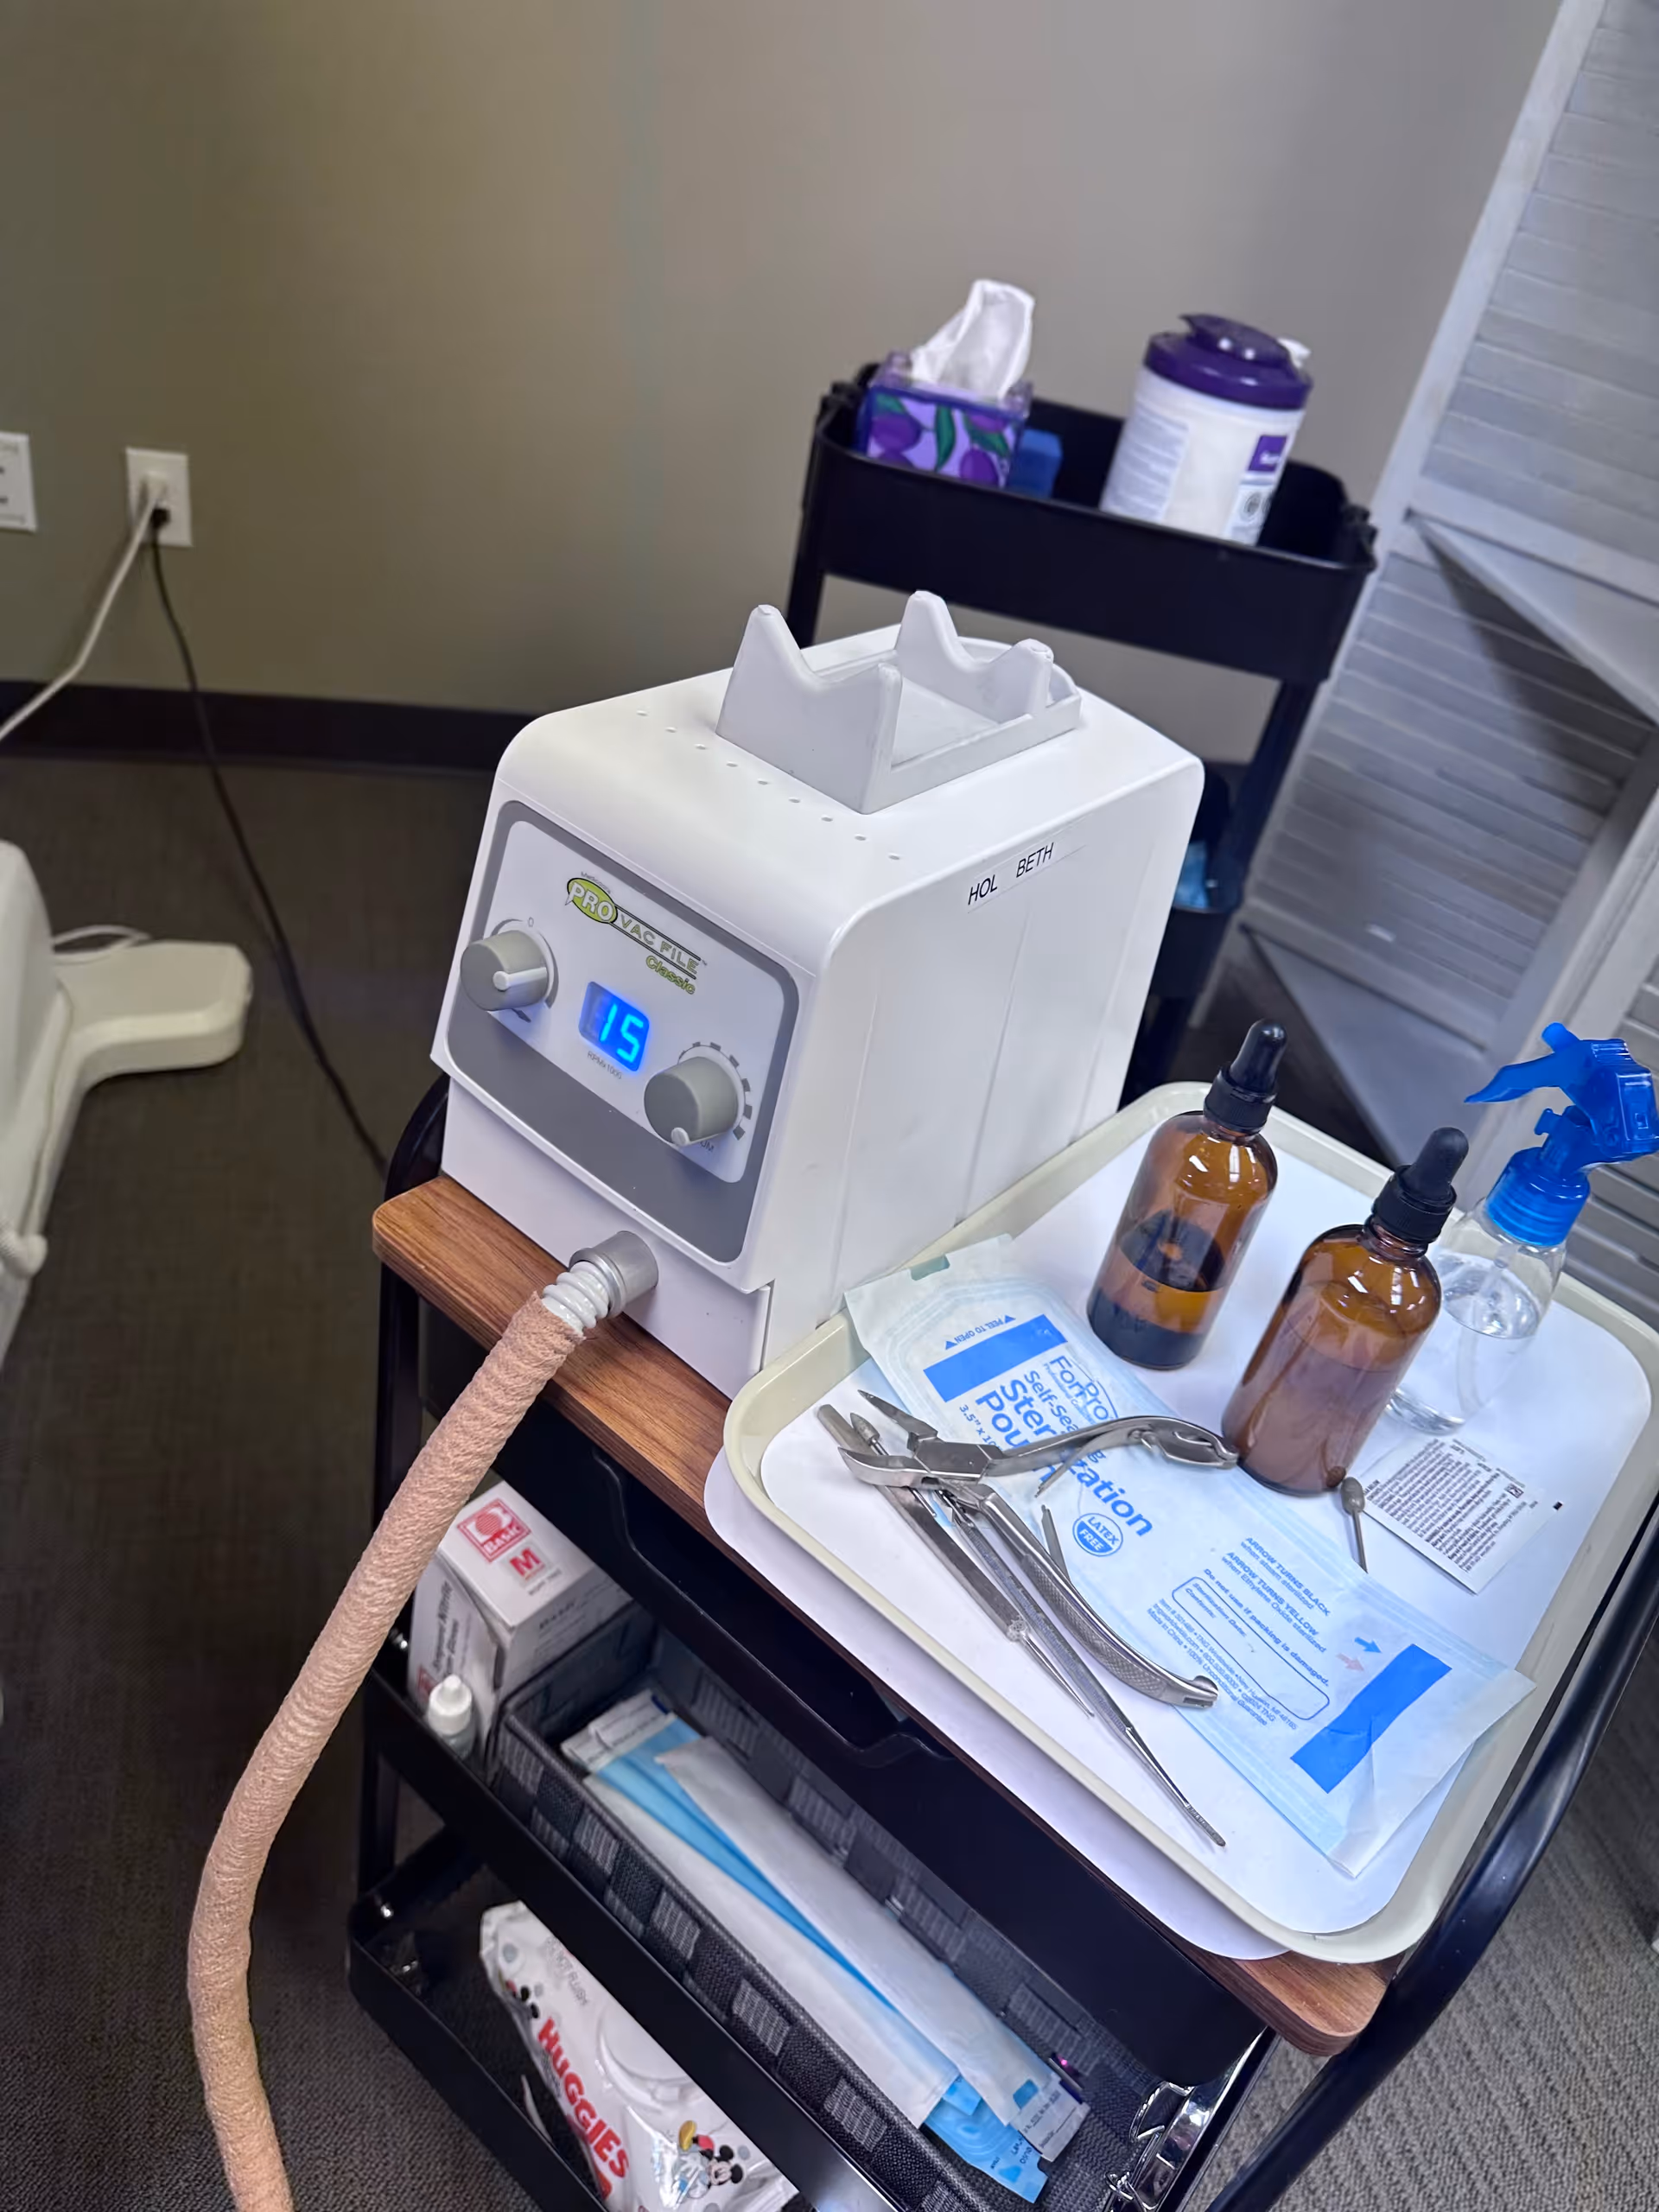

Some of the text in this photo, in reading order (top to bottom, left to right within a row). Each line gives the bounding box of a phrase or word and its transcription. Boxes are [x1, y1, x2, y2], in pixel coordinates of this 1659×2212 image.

[968, 842, 1054, 906] HOL BETH
[565, 881, 613, 921] PRO
[620, 914, 657, 946] VAC
[660, 940, 699, 975] FILE
[645, 955, 696, 995] Classic
[600, 1003, 644, 1063] 15
[954, 1319, 1004, 1344] PEEL TO OPEN
[509, 1548, 541, 1578] M
[1078, 1529, 1104, 1551] FREE
[1087, 1516, 1119, 1546] LATEX
[1222, 1556, 1327, 1653] when Ethylene Oxide sterilized
[1226, 1552, 1319, 1637] ARROW TURNS YELLOW
[1241, 1541, 1261, 1560] when
[1281, 1580, 1314, 1610] sterilized
[1245, 1537, 1331, 1617] ARROW TURNS BLACK
[1204, 1568, 1329, 1687] Do not use if packing is damaged.
